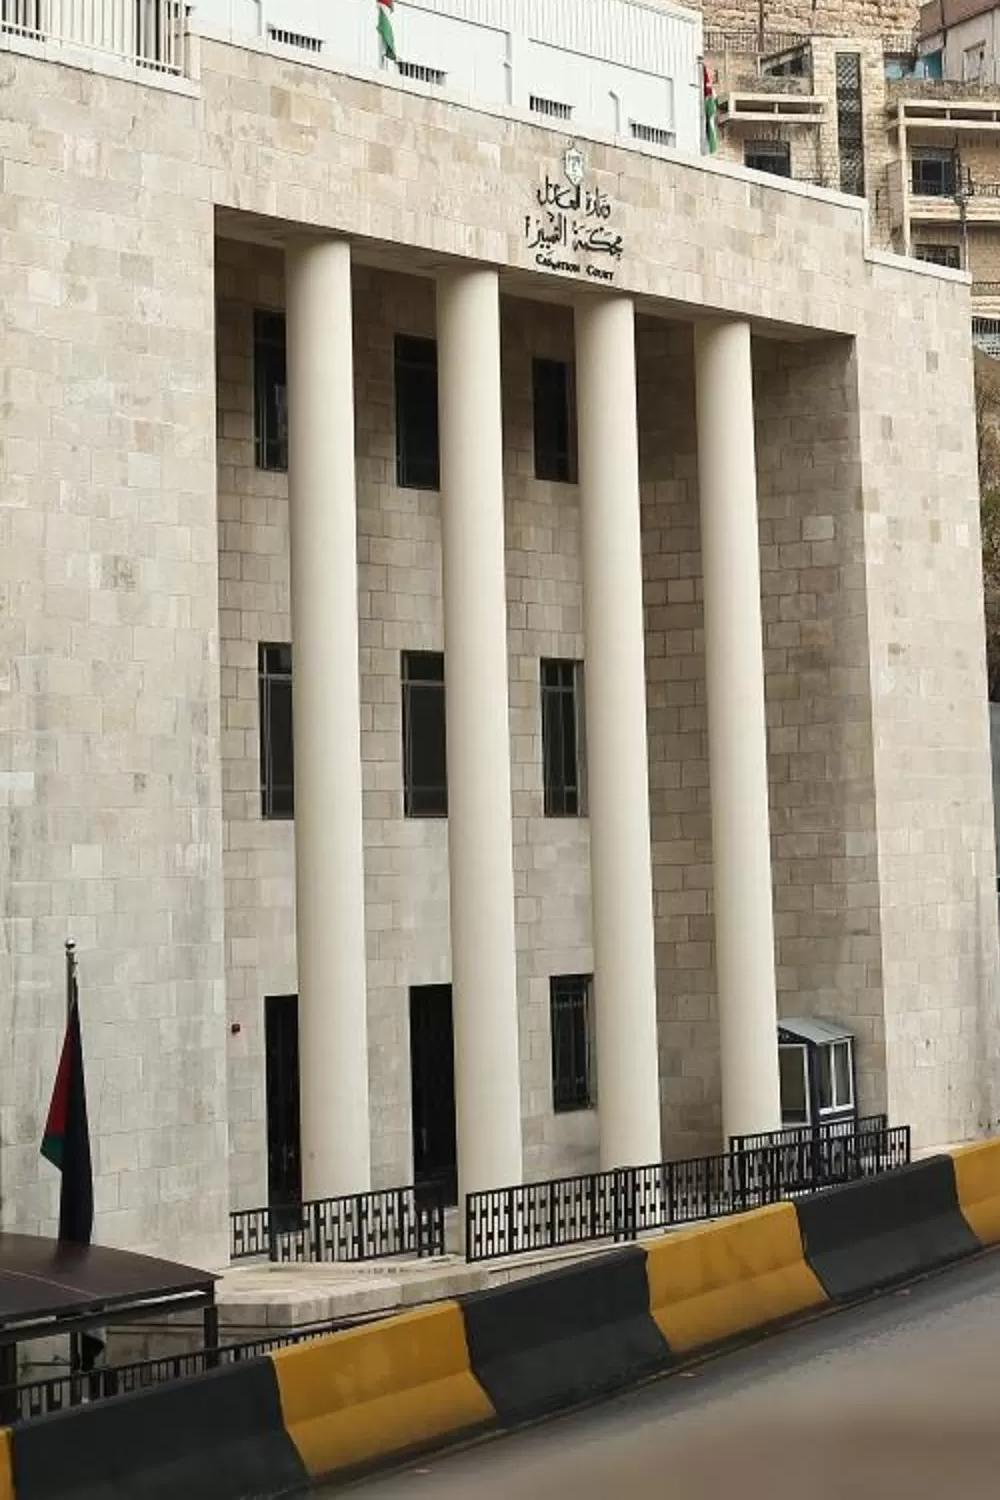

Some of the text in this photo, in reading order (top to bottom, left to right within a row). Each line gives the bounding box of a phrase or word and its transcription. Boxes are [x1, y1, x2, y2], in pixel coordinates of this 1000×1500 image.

[537, 176, 611, 219] وزارة العدل
[571, 221, 624, 259] محكمة
